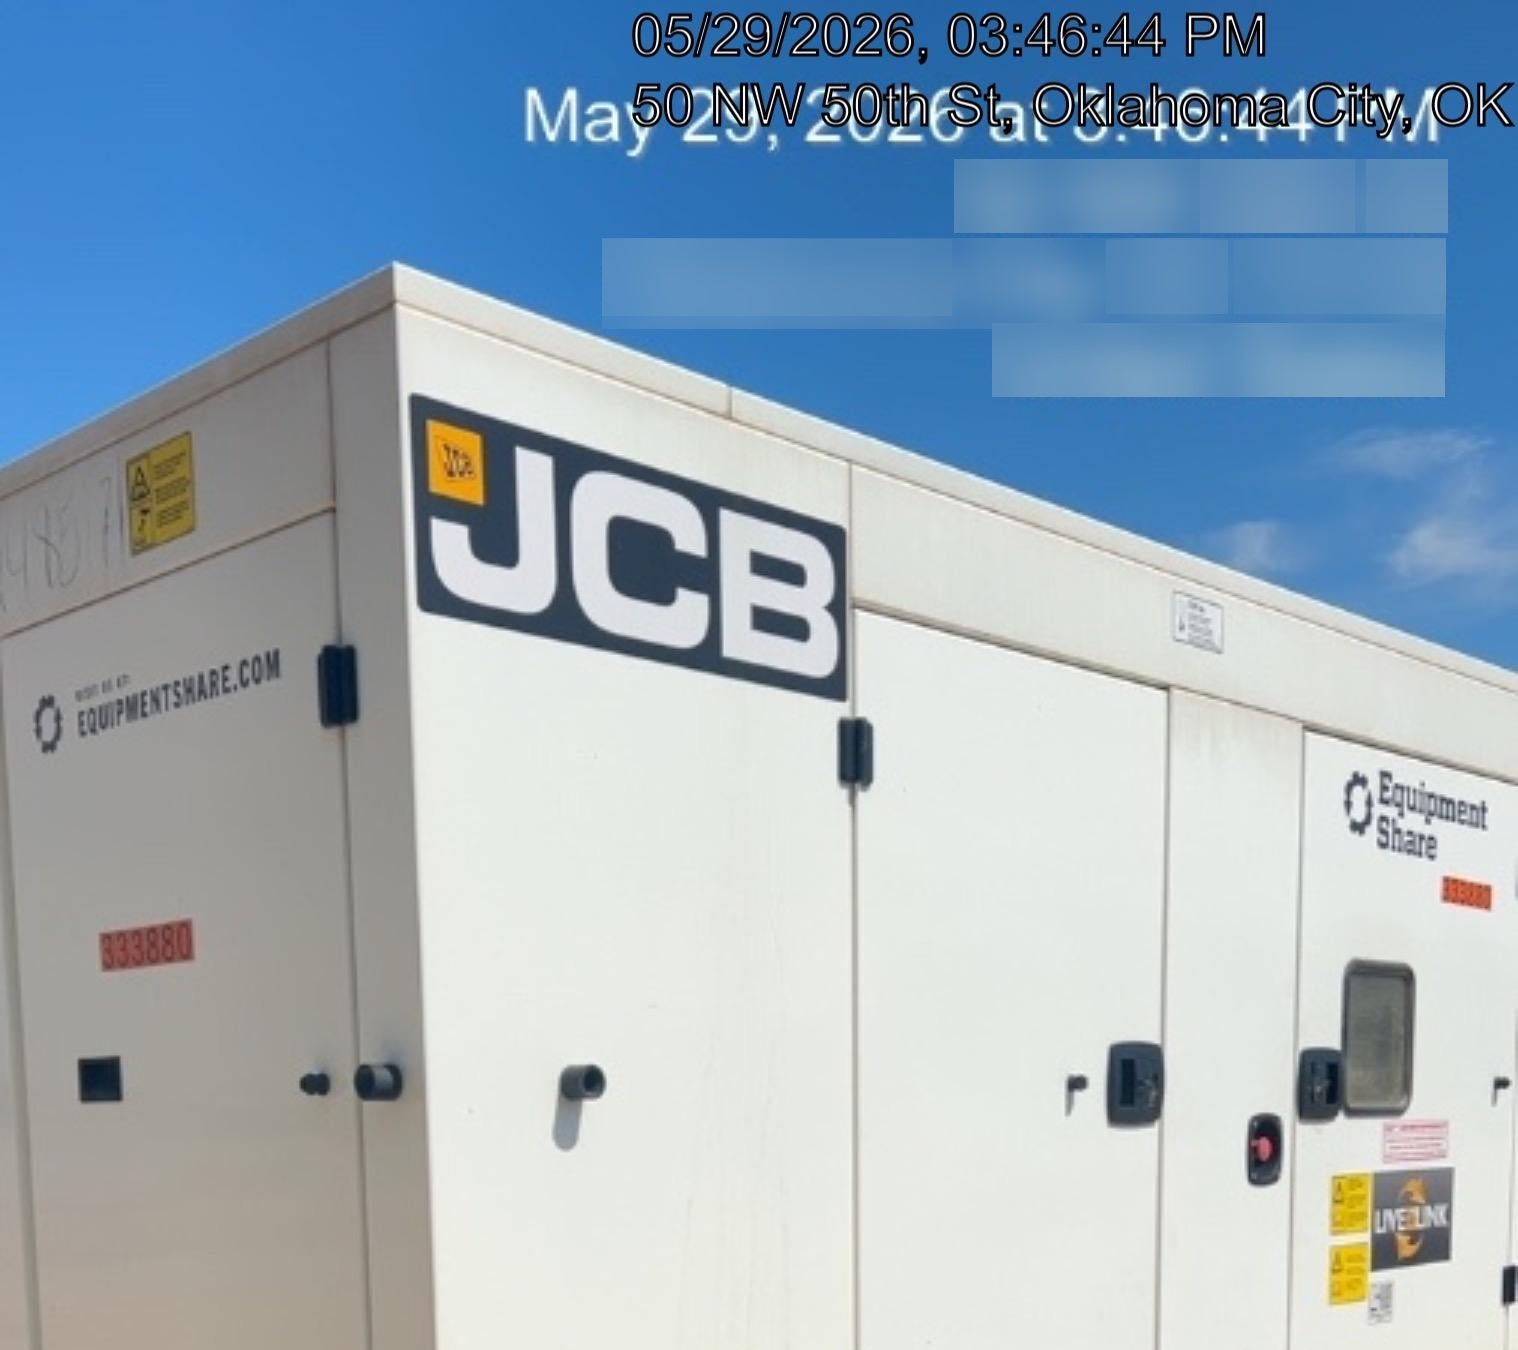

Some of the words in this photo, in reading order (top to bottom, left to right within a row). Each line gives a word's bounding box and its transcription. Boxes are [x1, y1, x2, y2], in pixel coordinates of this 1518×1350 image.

[430, 445, 839, 679] JCB
[77, 648, 281, 739] EQUIPMENTSHARE.COM
[1377, 815, 1438, 861] Share
[1379, 770, 1488, 831] Equipment
